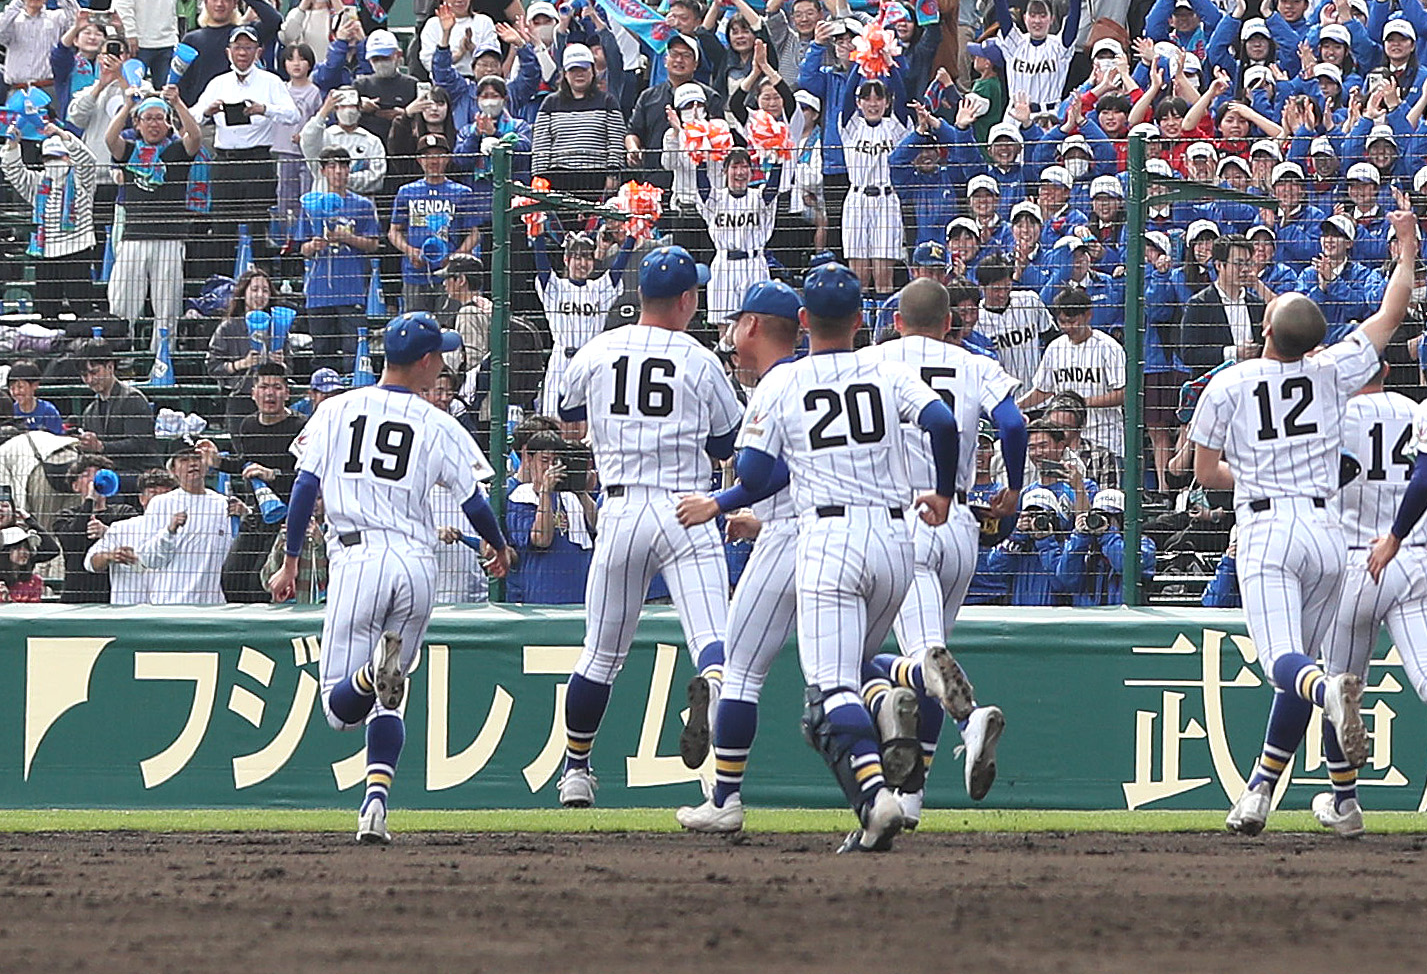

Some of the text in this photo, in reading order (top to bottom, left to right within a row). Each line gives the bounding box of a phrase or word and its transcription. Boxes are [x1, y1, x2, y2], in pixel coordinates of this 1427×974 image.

[408, 198, 456, 215] KENDAI
[609, 355, 677, 418] 16
[803, 381, 887, 451] 20
[1252, 376, 1319, 442] 12
[344, 414, 417, 480] 19
[1367, 422, 1414, 481] 14
